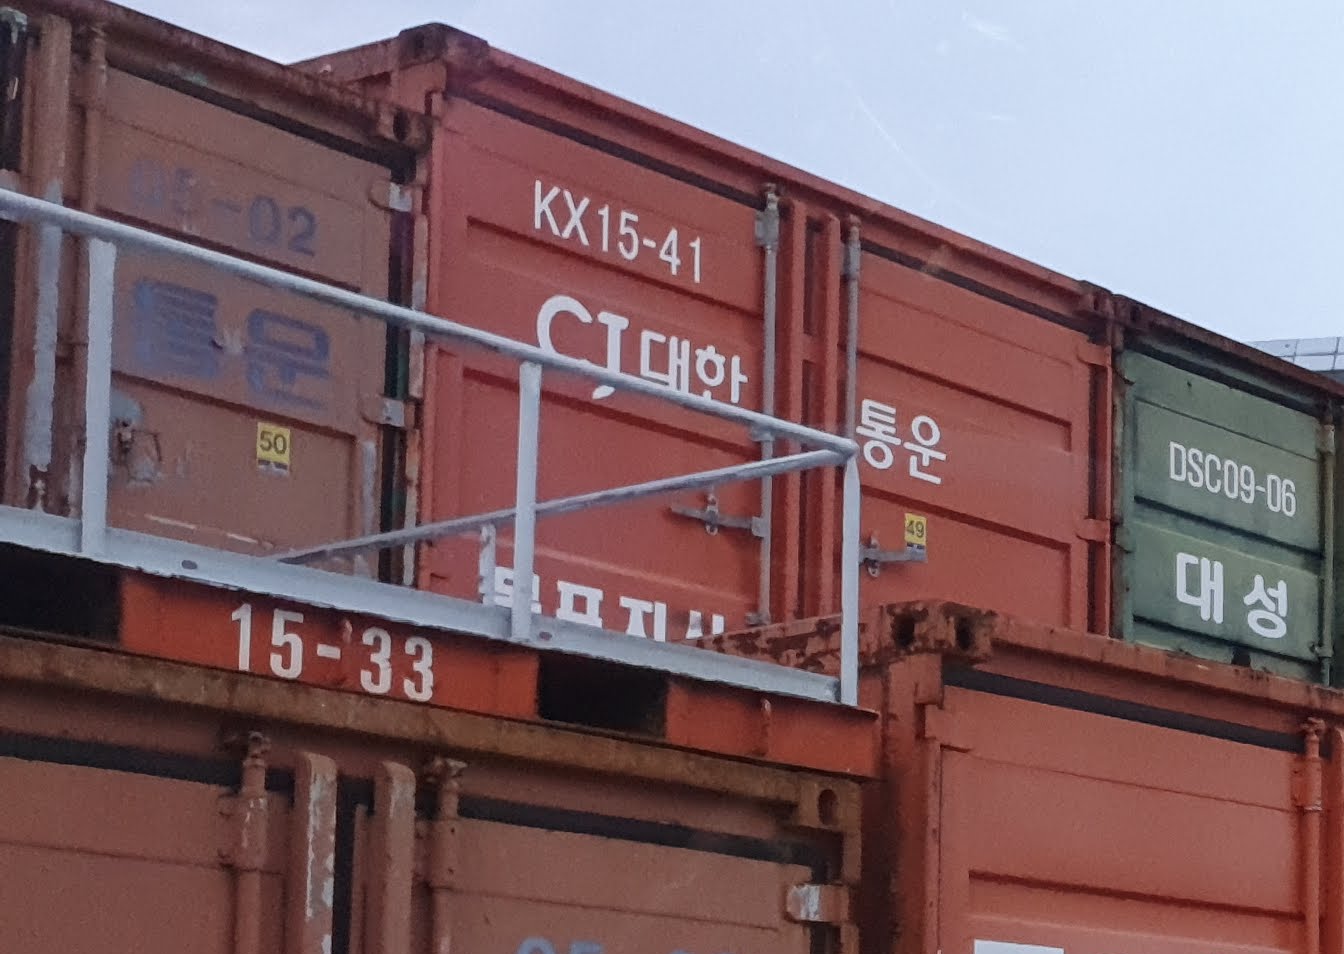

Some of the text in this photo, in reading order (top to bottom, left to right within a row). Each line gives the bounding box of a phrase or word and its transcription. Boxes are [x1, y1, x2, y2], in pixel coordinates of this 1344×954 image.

[534, 179, 701, 284] KX15-41
[260, 430, 287, 455] 50
[856, 398, 947, 485] 통운
[1169, 441, 1297, 517] DSC09-06
[231, 603, 435, 702] 15-33
